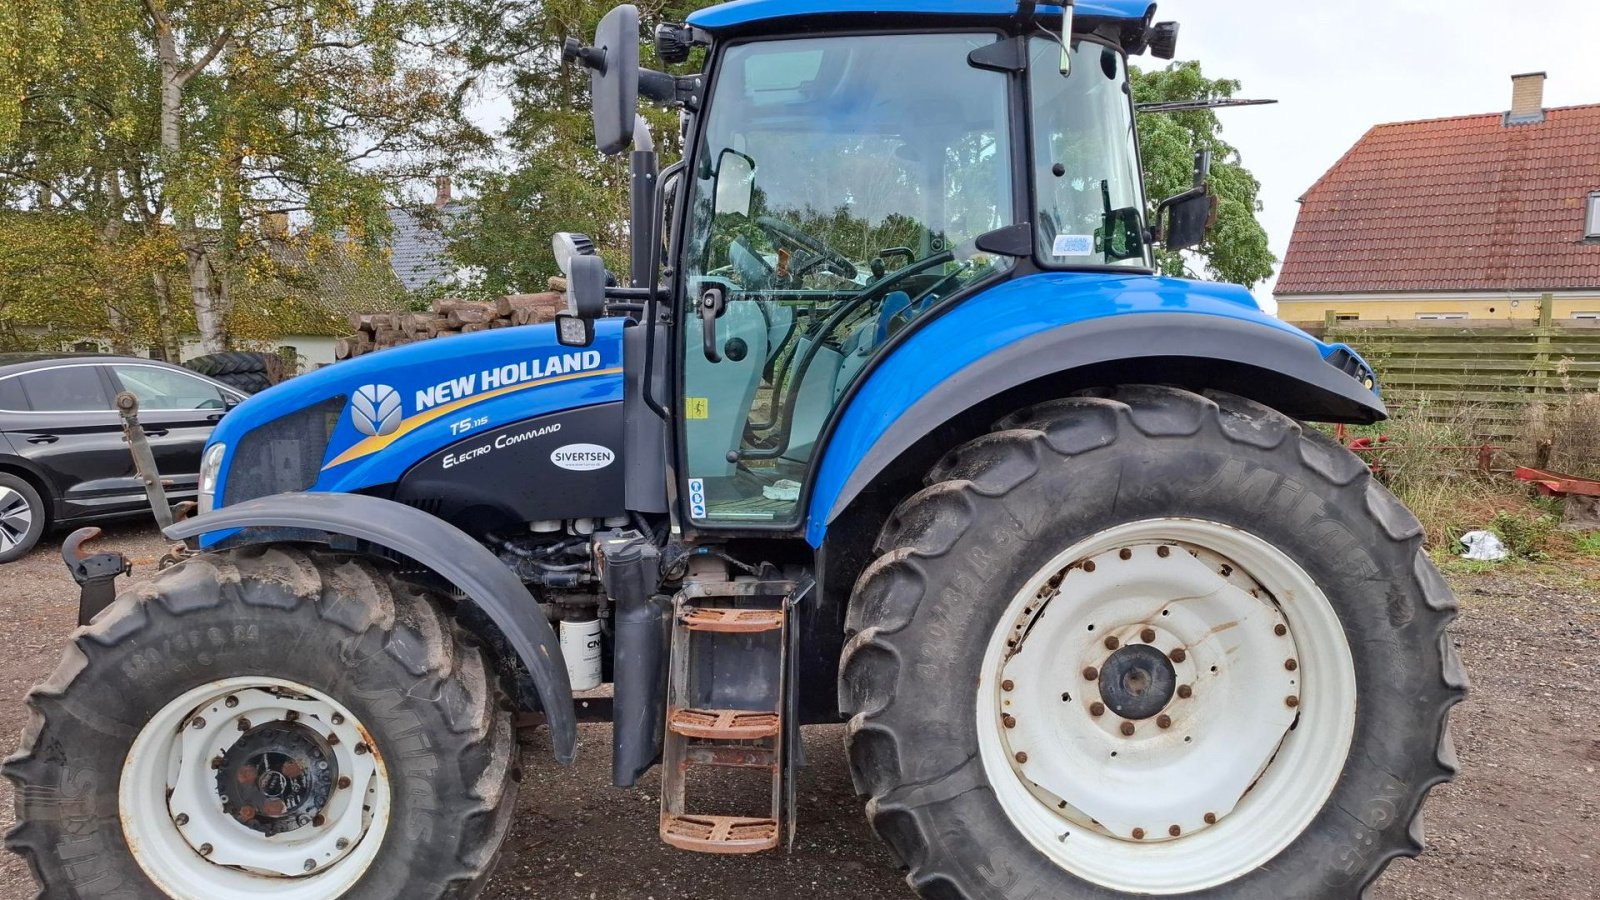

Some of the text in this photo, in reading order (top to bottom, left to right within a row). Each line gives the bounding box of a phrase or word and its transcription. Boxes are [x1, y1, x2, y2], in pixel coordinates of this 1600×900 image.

[416, 350, 601, 411] NEW HOLLAND
[450, 416, 488, 436] T5.115
[442, 423, 561, 469] ELECTRO COMMAND
[555, 452, 610, 461] SIVERTSEN
